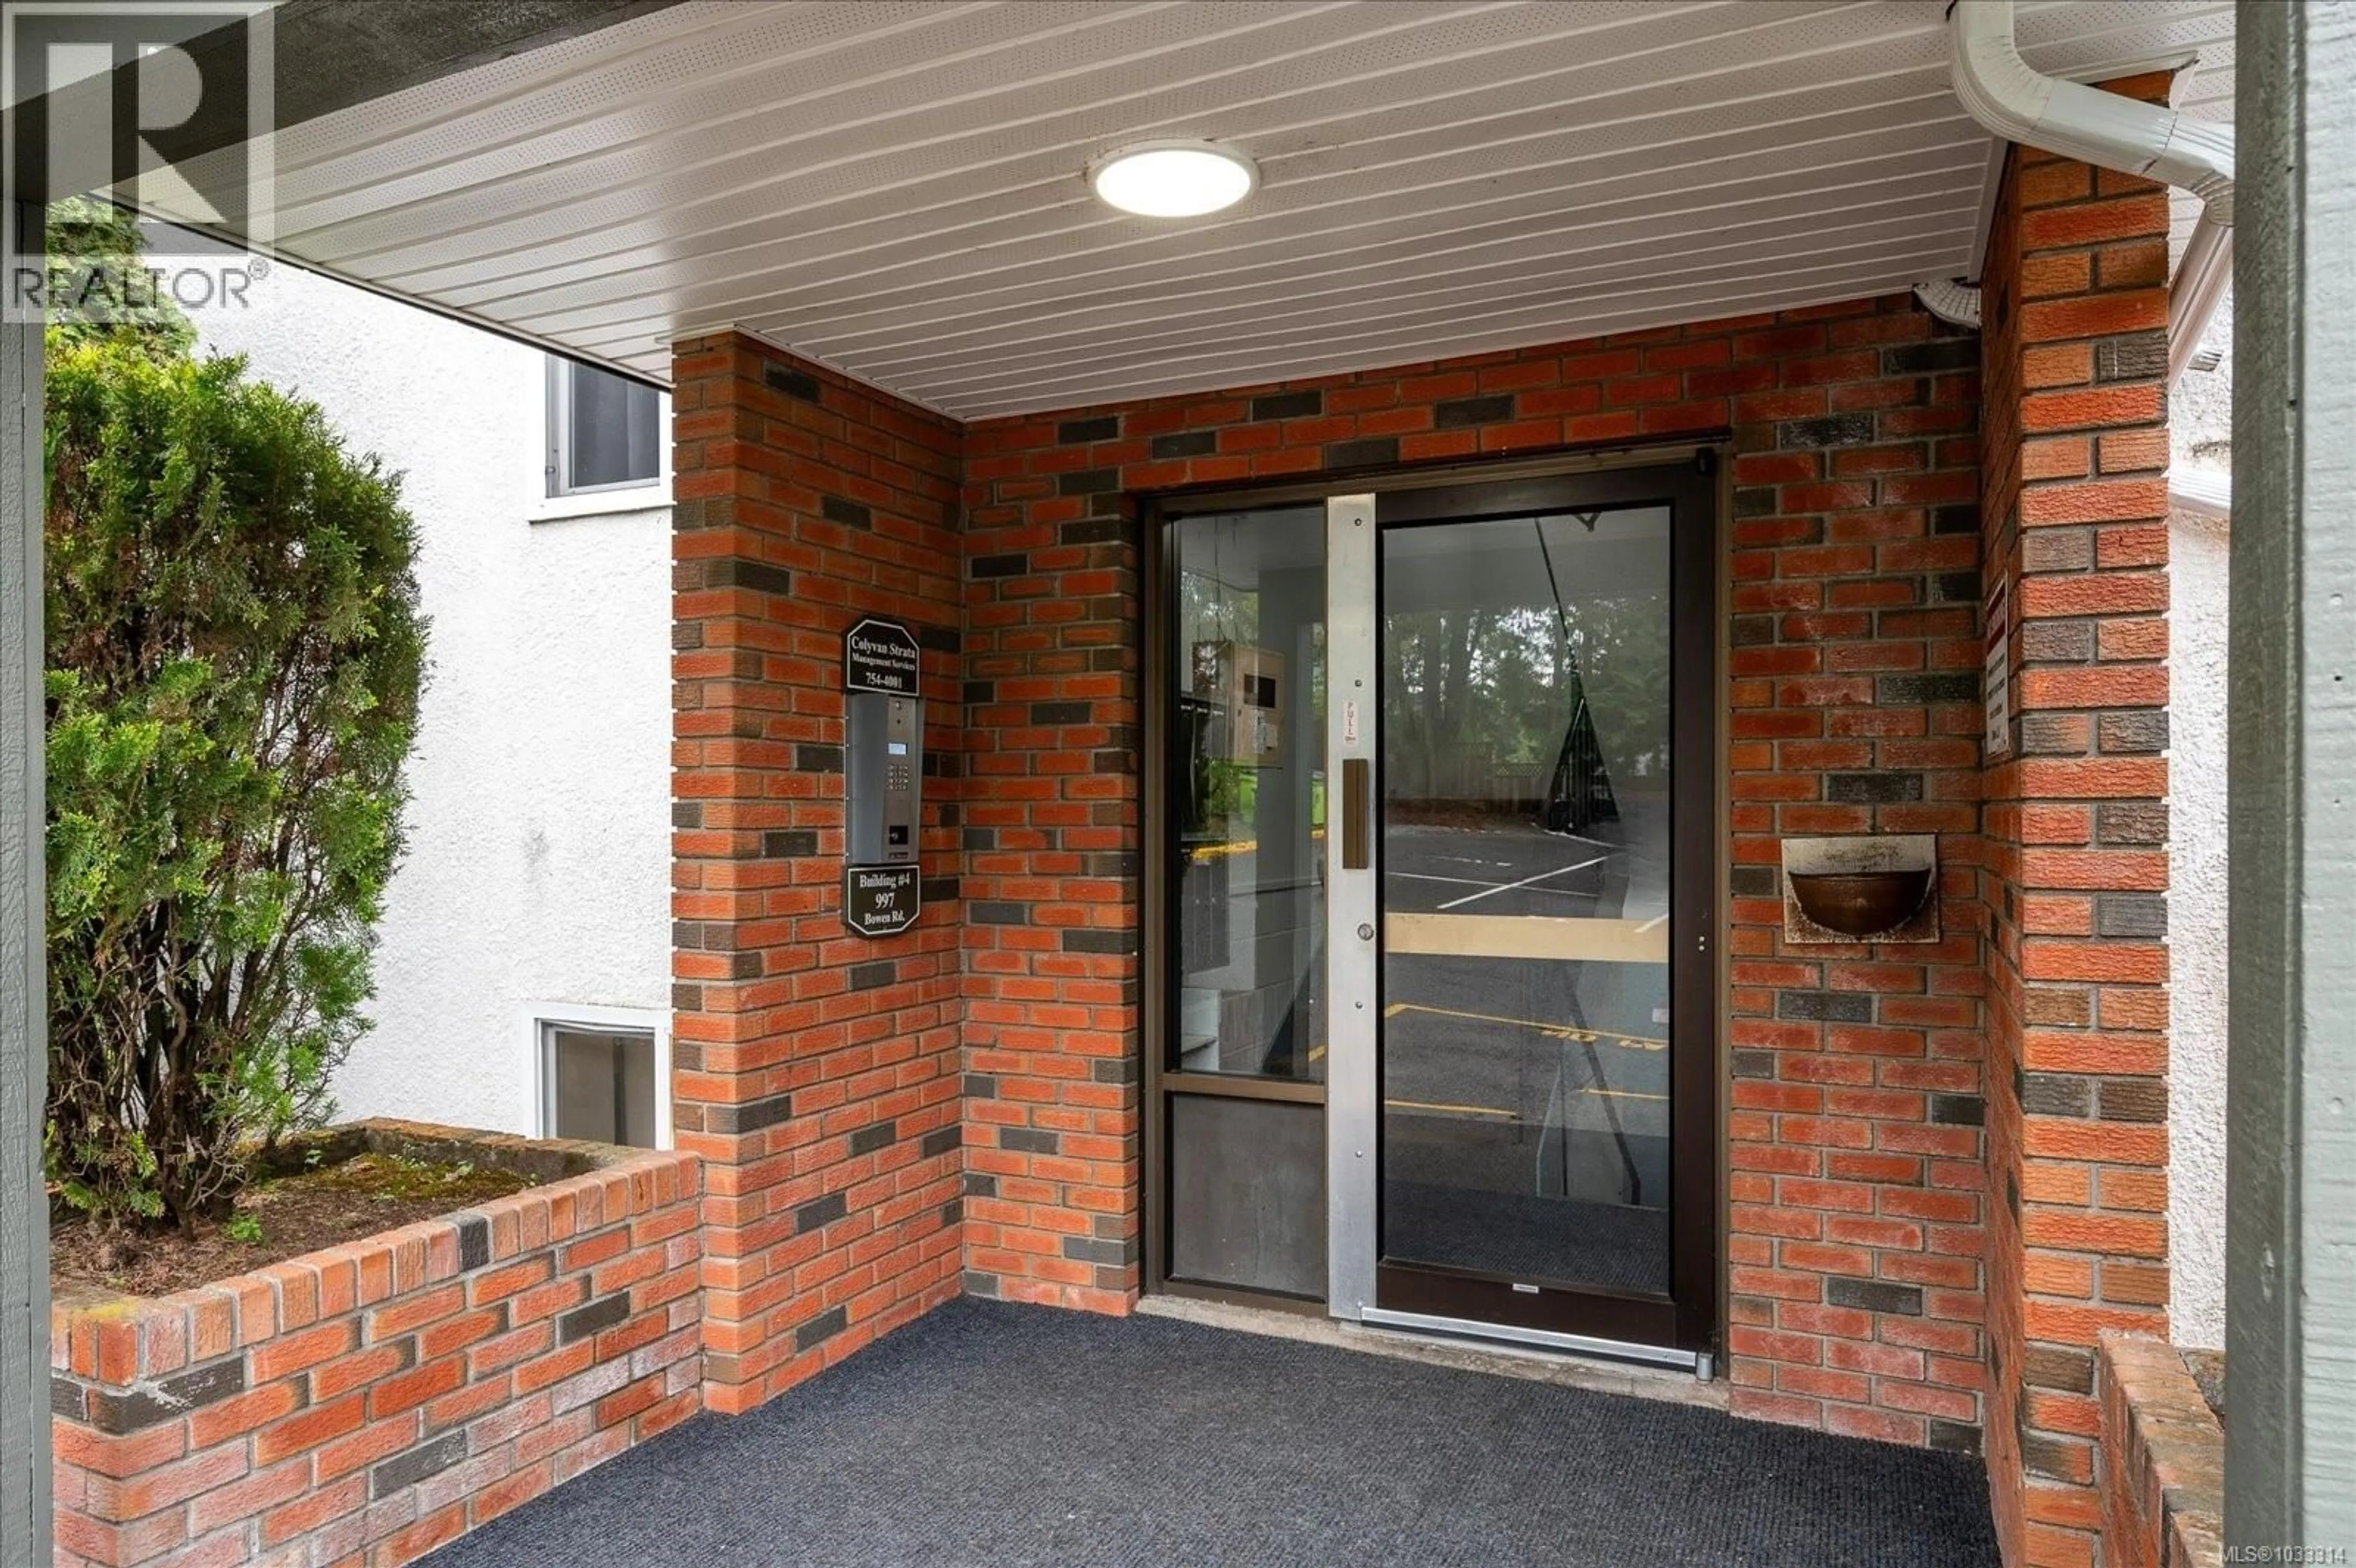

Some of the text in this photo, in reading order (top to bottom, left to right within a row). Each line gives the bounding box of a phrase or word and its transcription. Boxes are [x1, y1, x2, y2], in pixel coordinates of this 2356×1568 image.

[851, 636, 915, 658] Colyvan Strata
[852, 651, 891, 666] Management
[860, 873, 910, 889] Building #4
[876, 893, 895, 909] 997
[864, 913, 890, 925] Bowen
